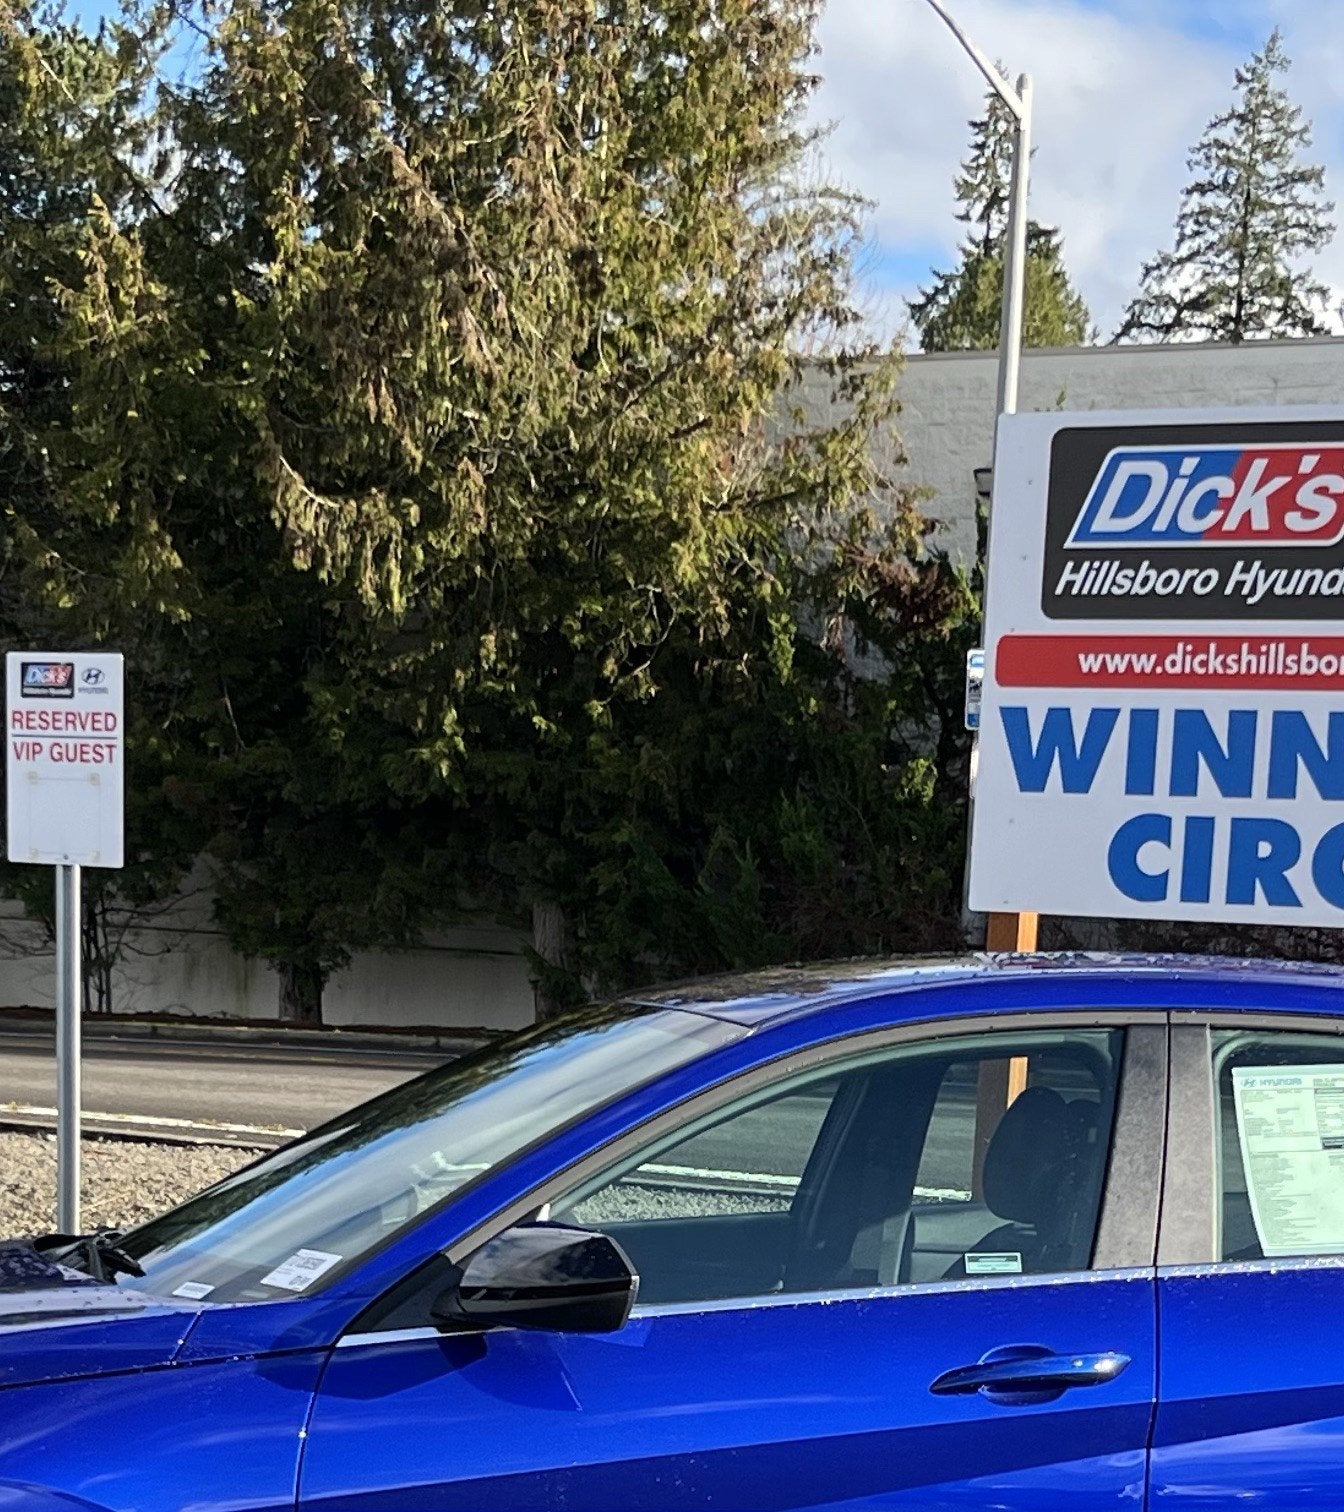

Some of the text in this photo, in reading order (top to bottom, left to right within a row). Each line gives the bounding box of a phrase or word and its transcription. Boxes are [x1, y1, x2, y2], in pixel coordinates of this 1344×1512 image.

[1054, 558, 1220, 597] Hillsboro
[11, 709, 117, 732] RESERVED
[13, 740, 117, 763] VIP GUEST
